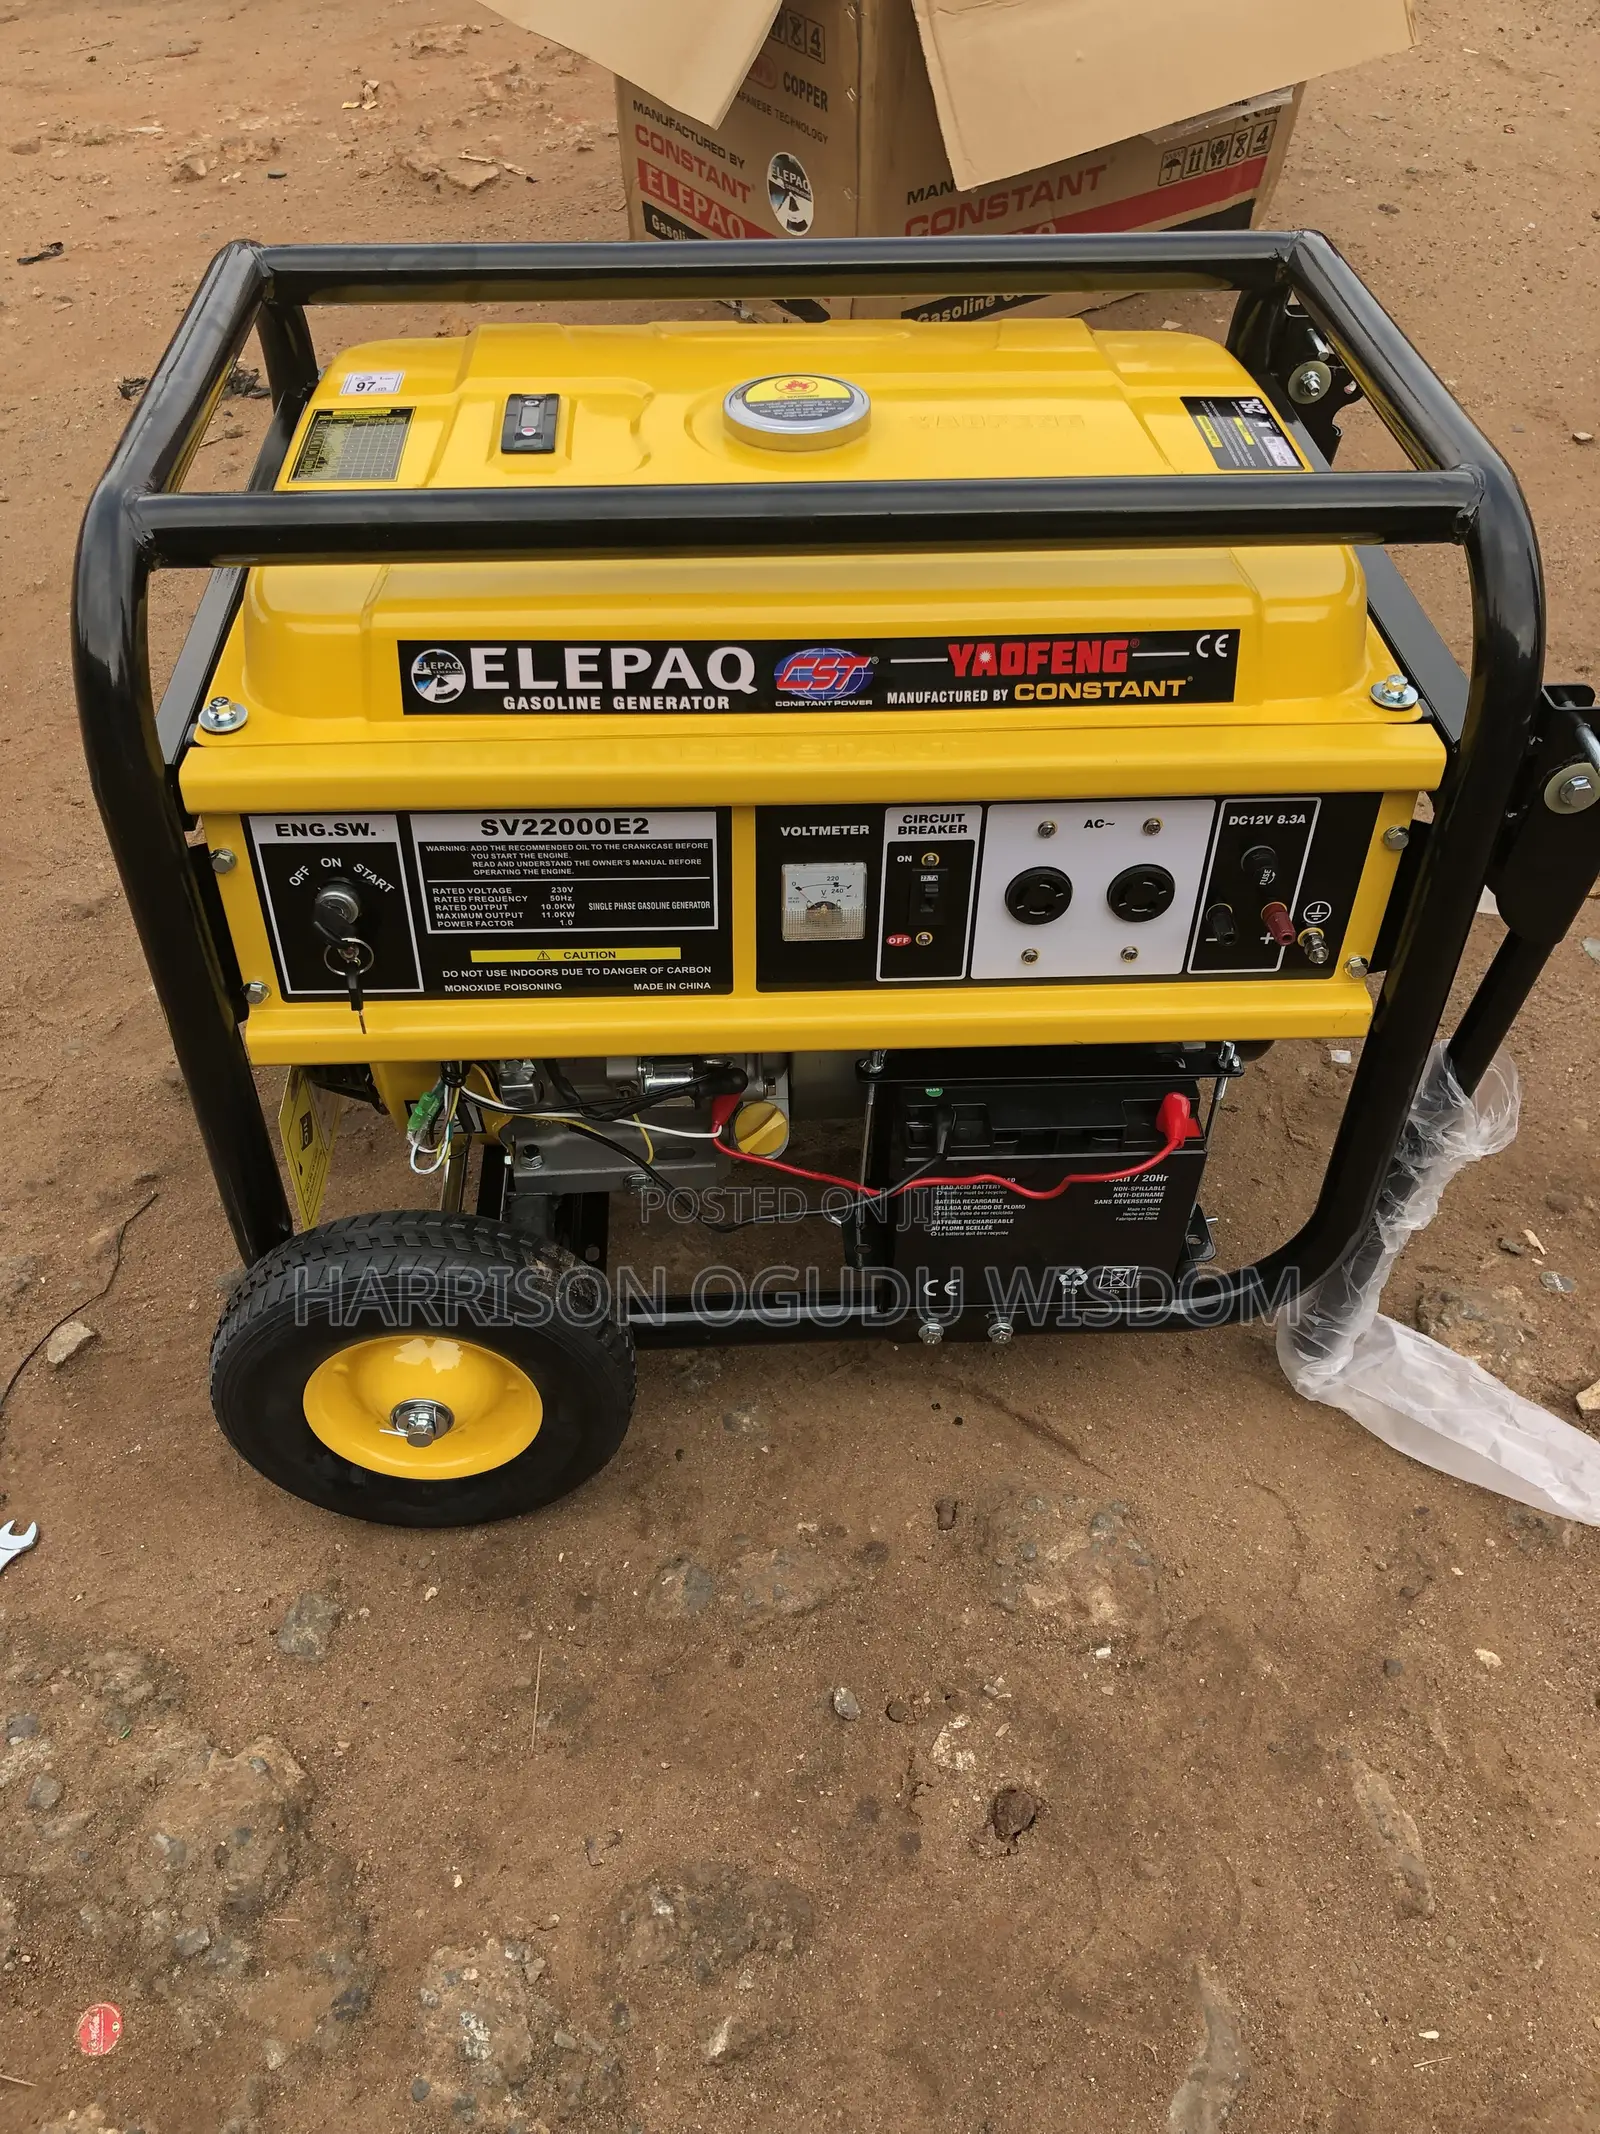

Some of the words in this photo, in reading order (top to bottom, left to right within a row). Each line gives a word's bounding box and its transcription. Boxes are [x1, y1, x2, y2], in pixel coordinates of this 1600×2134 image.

[783, 71, 828, 112] COPPER
[775, 108, 828, 144] TECHNOLOGY
[633, 100, 726, 159] MANUFACTURED
[729, 152, 745, 169] BY
[635, 124, 751, 204] CONSTANT
[772, 164, 812, 193] ELEPAQ
[905, 165, 1107, 236] CONSTANT
[355, 381, 376, 392] 97
[947, 639, 1130, 677] YAOFENG
[417, 662, 461, 670] ELEPAQ
[469, 646, 758, 694] ELEPAQ
[776, 657, 872, 690] CST
[887, 690, 989, 705] MANUFACTURED
[992, 689, 1009, 702] BY
[1014, 680, 1187, 701] CONSTANT
[503, 696, 601, 711] GASOLINE
[613, 695, 730, 710] GENERATOR
[902, 813, 966, 824] CIRCUIT
[1228, 815, 1274, 826] DC12V
[1276, 814, 1306, 825] 8.3A
[275, 823, 376, 837] ENG.SW.
[481, 818, 650, 836] SV22000E2
[781, 825, 870, 837] VOLTMETER
[897, 824, 968, 836] BREAKER
[320, 857, 342, 868] ON
[896, 855, 913, 863] ON
[289, 865, 311, 886] OFF
[353, 863, 395, 893] START
[1259, 868, 1272, 886] FUSE
[435, 904, 468, 912] RATED
[588, 902, 613, 911] SINGLE
[614, 902, 636, 910] PHASE
[637, 901, 671, 910] GASOLINE
[672, 901, 711, 909] GENERATOR
[888, 936, 909, 944] OFF
[563, 951, 616, 960] CAUTION
[442, 970, 459, 978] DO
[461, 970, 483, 978] NOT
[486, 969, 508, 978] USE
[510, 969, 559, 977] INDOORS
[561, 968, 583, 976] DUE
[586, 968, 601, 976] TO
[603, 967, 647, 976] DANGER
[666, 966, 712, 974] CARBON
[444, 984, 501, 993] MONOXIDE
[504, 983, 562, 991] POISONING
[633, 983, 664, 991] MADE
[679, 982, 712, 990] CHINA
[1141, 1174, 1169, 1182] 20Hr
